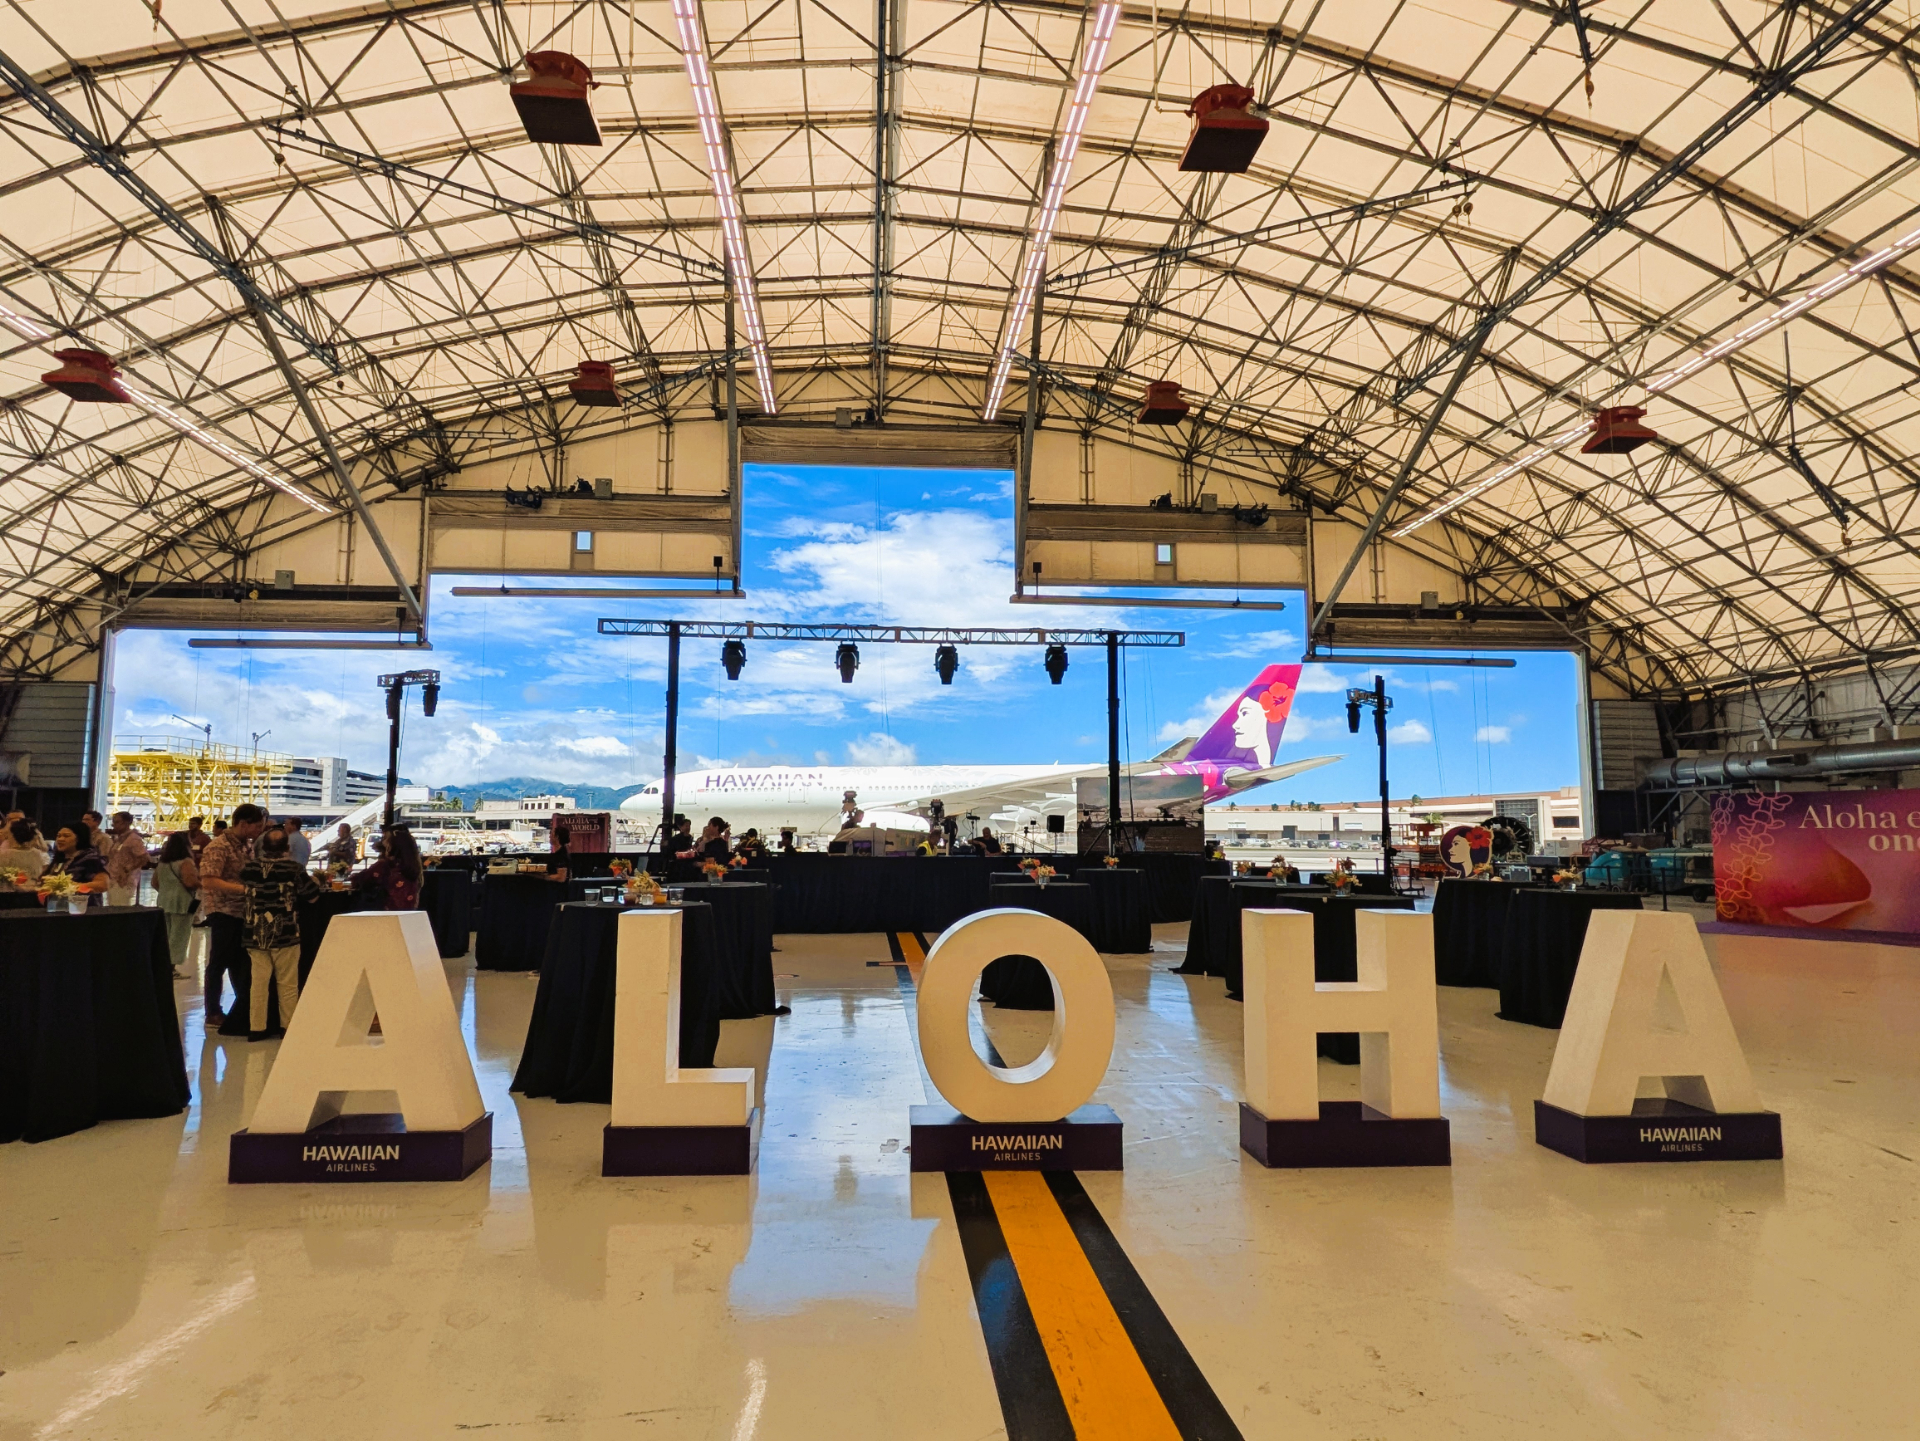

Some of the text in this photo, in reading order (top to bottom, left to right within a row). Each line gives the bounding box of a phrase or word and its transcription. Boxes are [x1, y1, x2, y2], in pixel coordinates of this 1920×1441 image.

[706, 774, 822, 787] HAWAIIAN
[1799, 804, 1899, 829] Aloha
[1640, 1126, 1722, 1142] HAWAIIAN
[971, 1134, 1063, 1151] HAWAIIAN
[302, 1145, 400, 1161] HAWAIIAN
